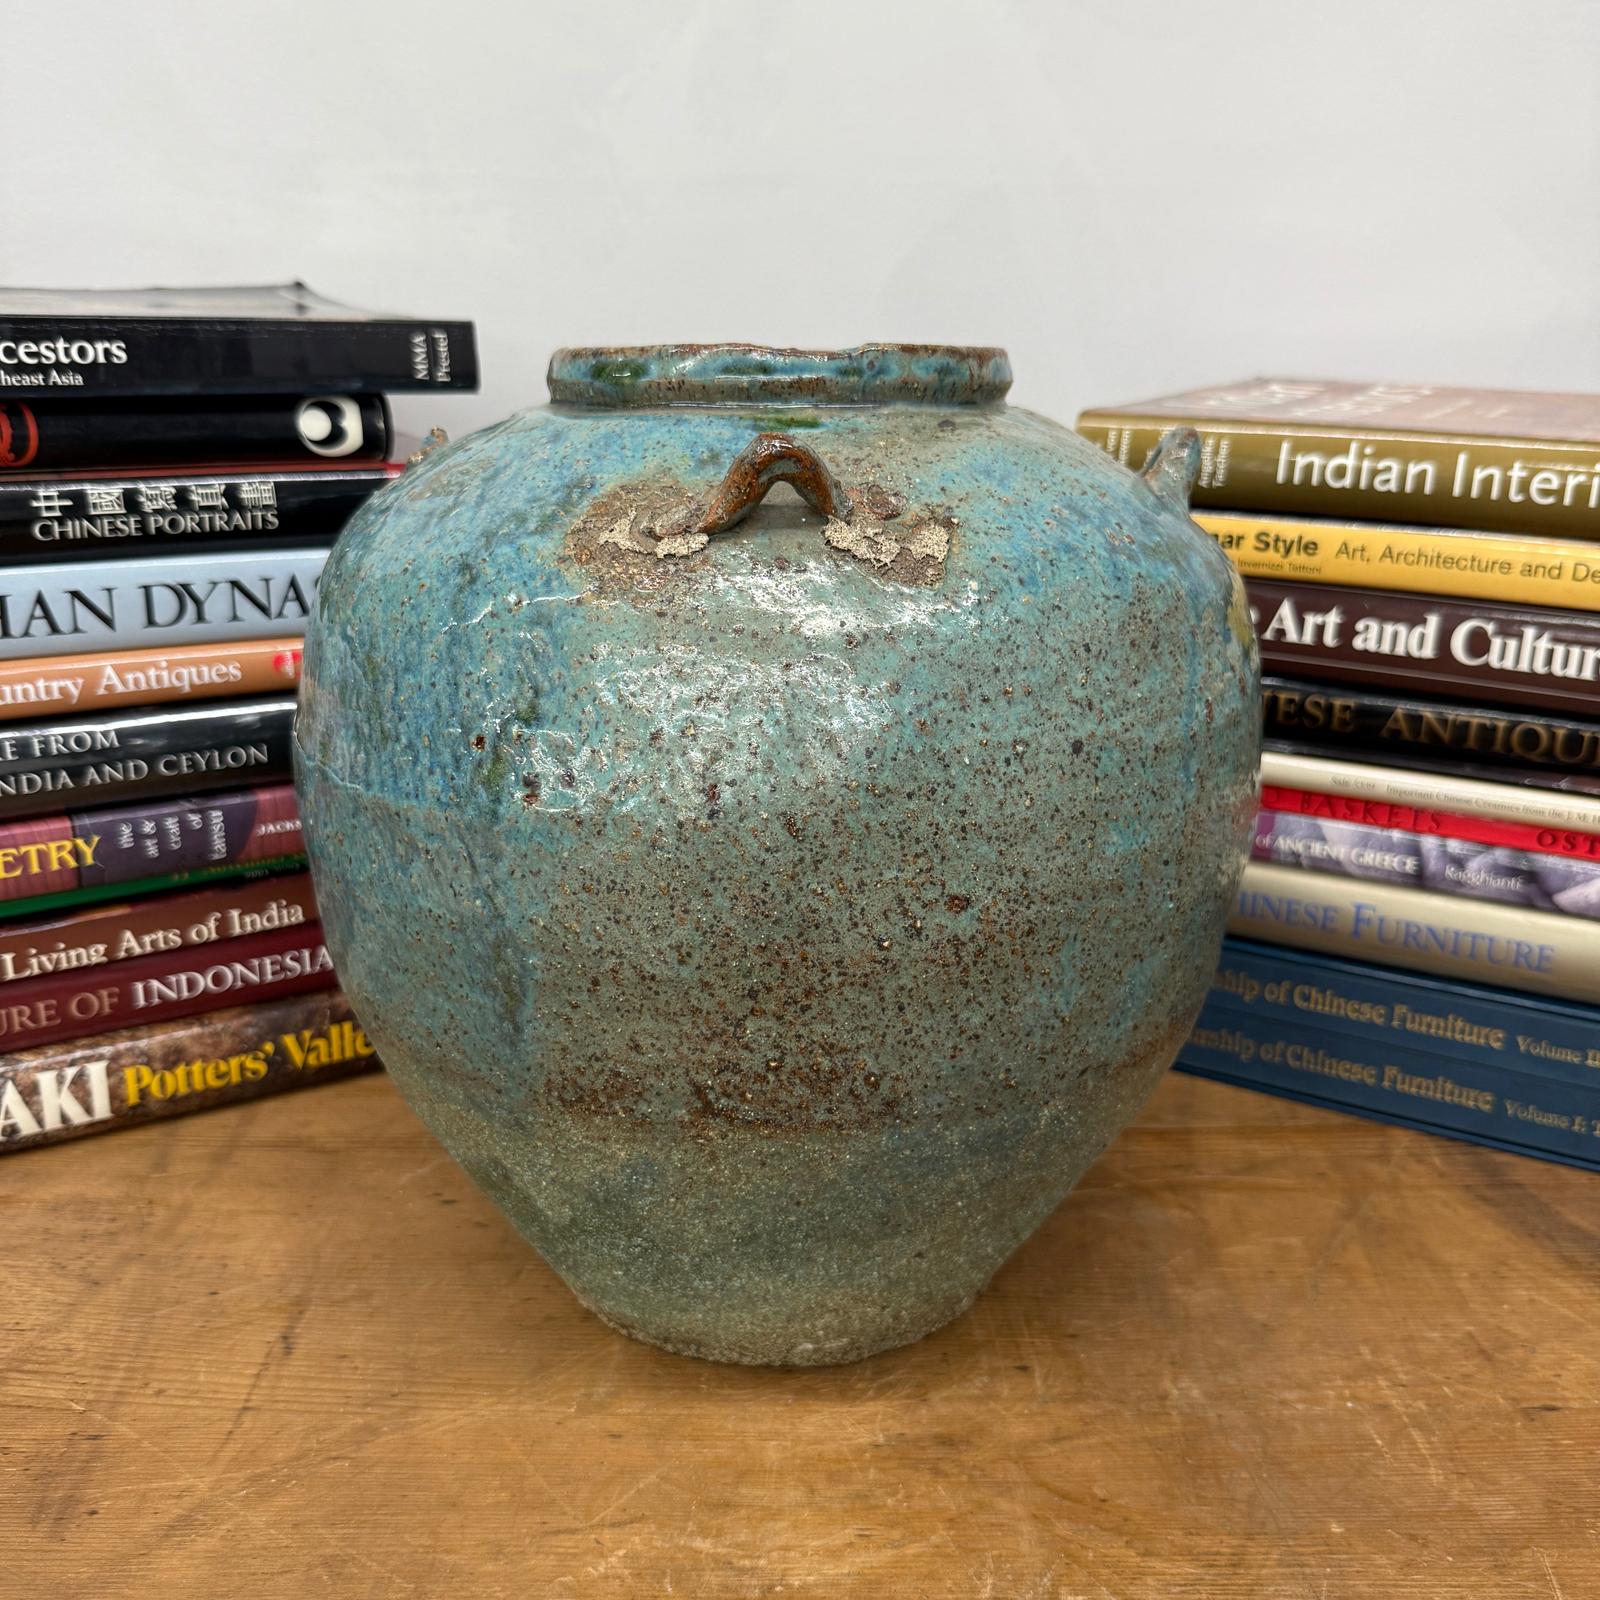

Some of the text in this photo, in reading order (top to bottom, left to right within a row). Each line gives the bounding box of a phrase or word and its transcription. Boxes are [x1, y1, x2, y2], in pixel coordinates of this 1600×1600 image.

[0, 335, 128, 365] cestors
[409, 331, 430, 380] MMA
[432, 328, 451, 382] Prestel
[0, 367, 85, 386] heast Asia
[1275, 439, 1600, 509] Indian Interi
[31, 508, 280, 542] CHINESE PORTRAITS
[1253, 531, 1319, 558] Style
[1335, 541, 1371, 564] Art,
[1380, 544, 1512, 576] Architecture
[1519, 561, 1563, 580] and
[1571, 562, 1600, 585] De
[138, 572, 321, 629] DYNA
[1260, 597, 1600, 681] Art and Cultur
[97, 659, 242, 694] Antiques
[31, 728, 120, 758] FROM
[1379, 706, 1600, 769] ANTIQU
[84, 758, 148, 784] AND
[157, 744, 269, 777] CEYLON
[162, 815, 183, 850] craft
[187, 812, 203, 830] of
[1300, 789, 1441, 832] BASKETS
[0, 834, 101, 880] ETRY
[118, 821, 135, 849] the
[141, 819, 160, 859] art &
[207, 809, 228, 861] tansu
[1255, 831, 1420, 875] of ANCIENT GREECE
[1444, 862, 1522, 891] Ragghianti
[0, 899, 305, 982] Living Arts of India
[1352, 901, 1557, 974] FURNITURE
[71, 985, 120, 1020] OF
[131, 943, 335, 1010] INDONESIA
[1264, 979, 1292, 1005] of
[1293, 983, 1387, 1026] Chinese
[1392, 1003, 1506, 1051] Furniture
[1515, 1034, 1582, 1065] Volume
[0, 1021, 377, 1143] AKI Potters’ Valle
[1259, 1039, 1287, 1063] of
[1286, 1043, 1377, 1087] Chinese
[1381, 1063, 1496, 1114] Furniture
[1503, 1098, 1570, 1131] Volume
